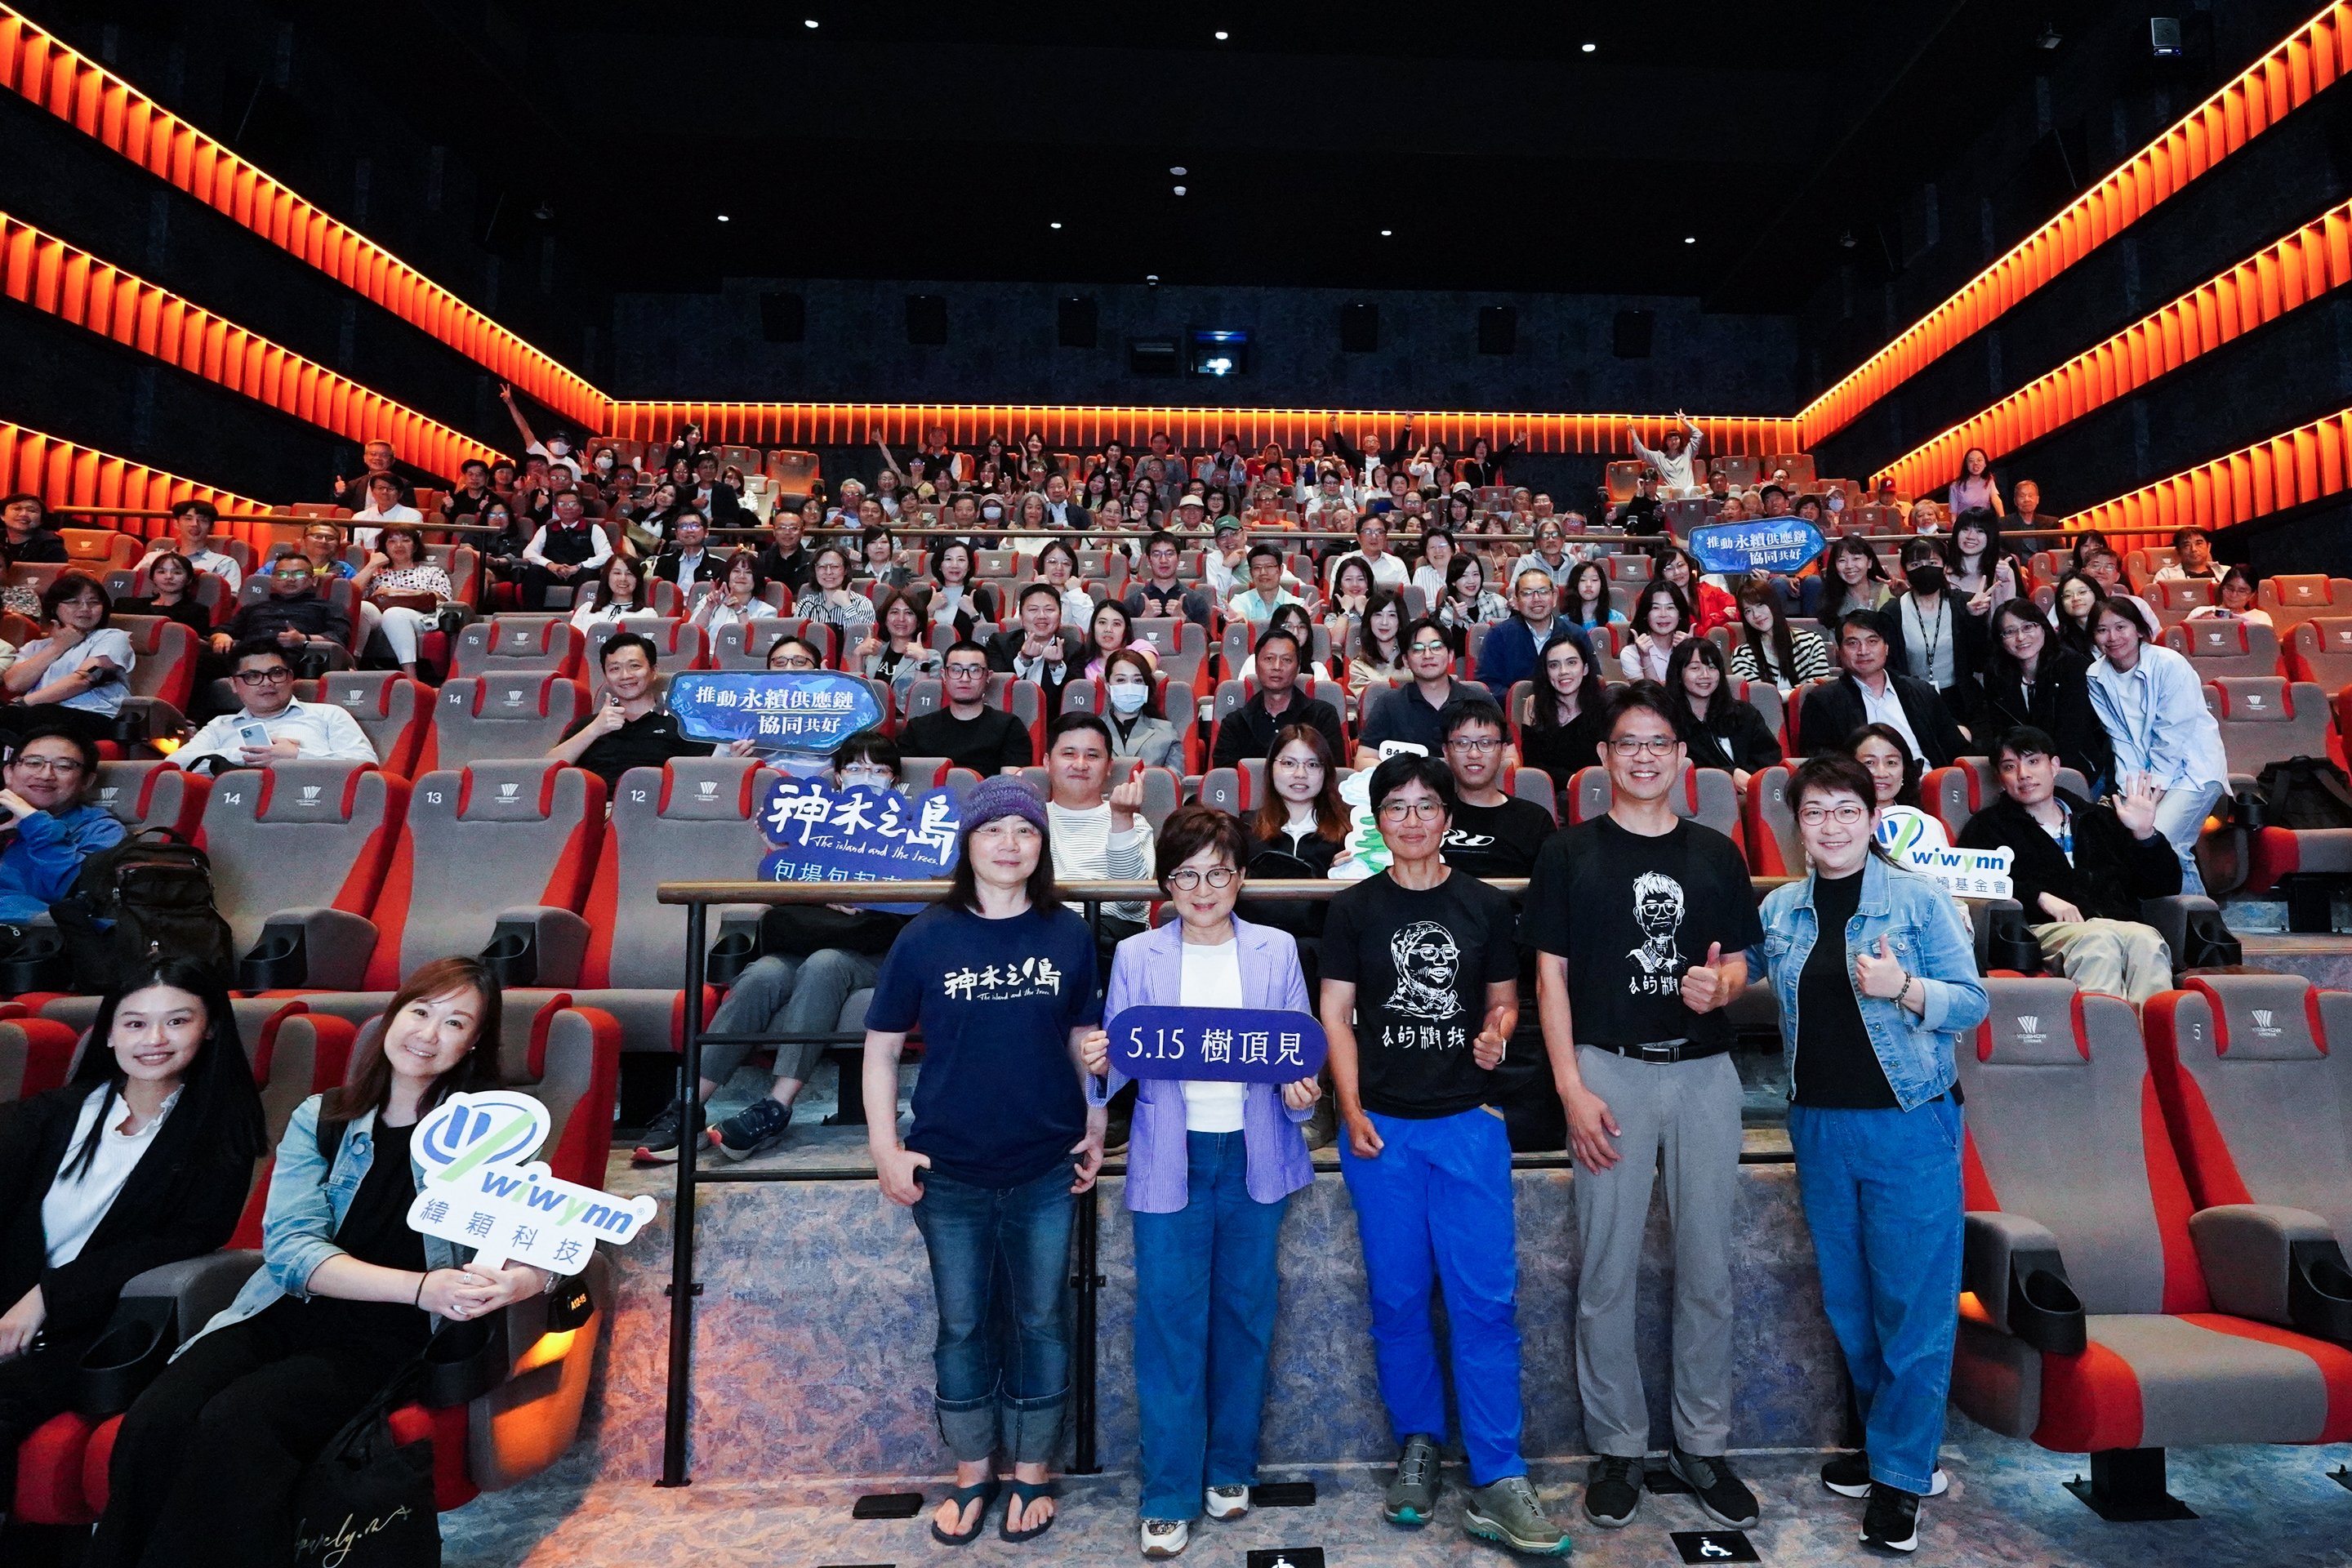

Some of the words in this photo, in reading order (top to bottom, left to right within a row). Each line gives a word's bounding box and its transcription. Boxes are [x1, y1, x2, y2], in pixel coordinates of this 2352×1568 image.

[1707, 530, 1807, 549] 推動永續供應鏈
[1749, 549, 1802, 565] 協同共好
[469, 636, 479, 644] 15
[1597, 639, 1603, 648] 6
[2175, 639, 2180, 648] 3
[449, 694, 461, 704] 14
[696, 686, 853, 709] 推動永續供應鏈
[921, 697, 930, 706] 11
[1075, 696, 1084, 705] 10
[1227, 696, 1234, 705] 9
[759, 715, 841, 735] 協同共好
[224, 792, 240, 804] 14
[427, 792, 442, 804] 13
[631, 790, 645, 801] 12
[1217, 790, 1224, 802] 9
[1592, 788, 1600, 800] 7
[1774, 789, 1780, 800] 6
[1953, 791, 1958, 802] 5
[767, 784, 960, 866] 神木之島
[809, 835, 833, 849] The
[835, 841, 866, 854] island
[868, 844, 887, 858] and
[1913, 848, 2004, 873] wiwynn
[944, 957, 1062, 1000] 神木之島
[2194, 1024, 2200, 1040] 5
[1127, 1026, 1185, 1059] 5.15
[1200, 1028, 1304, 1066] 樹頂見
[480, 1170, 635, 1235] wiwynn
[419, 1198, 582, 1264] 緯穎科技
